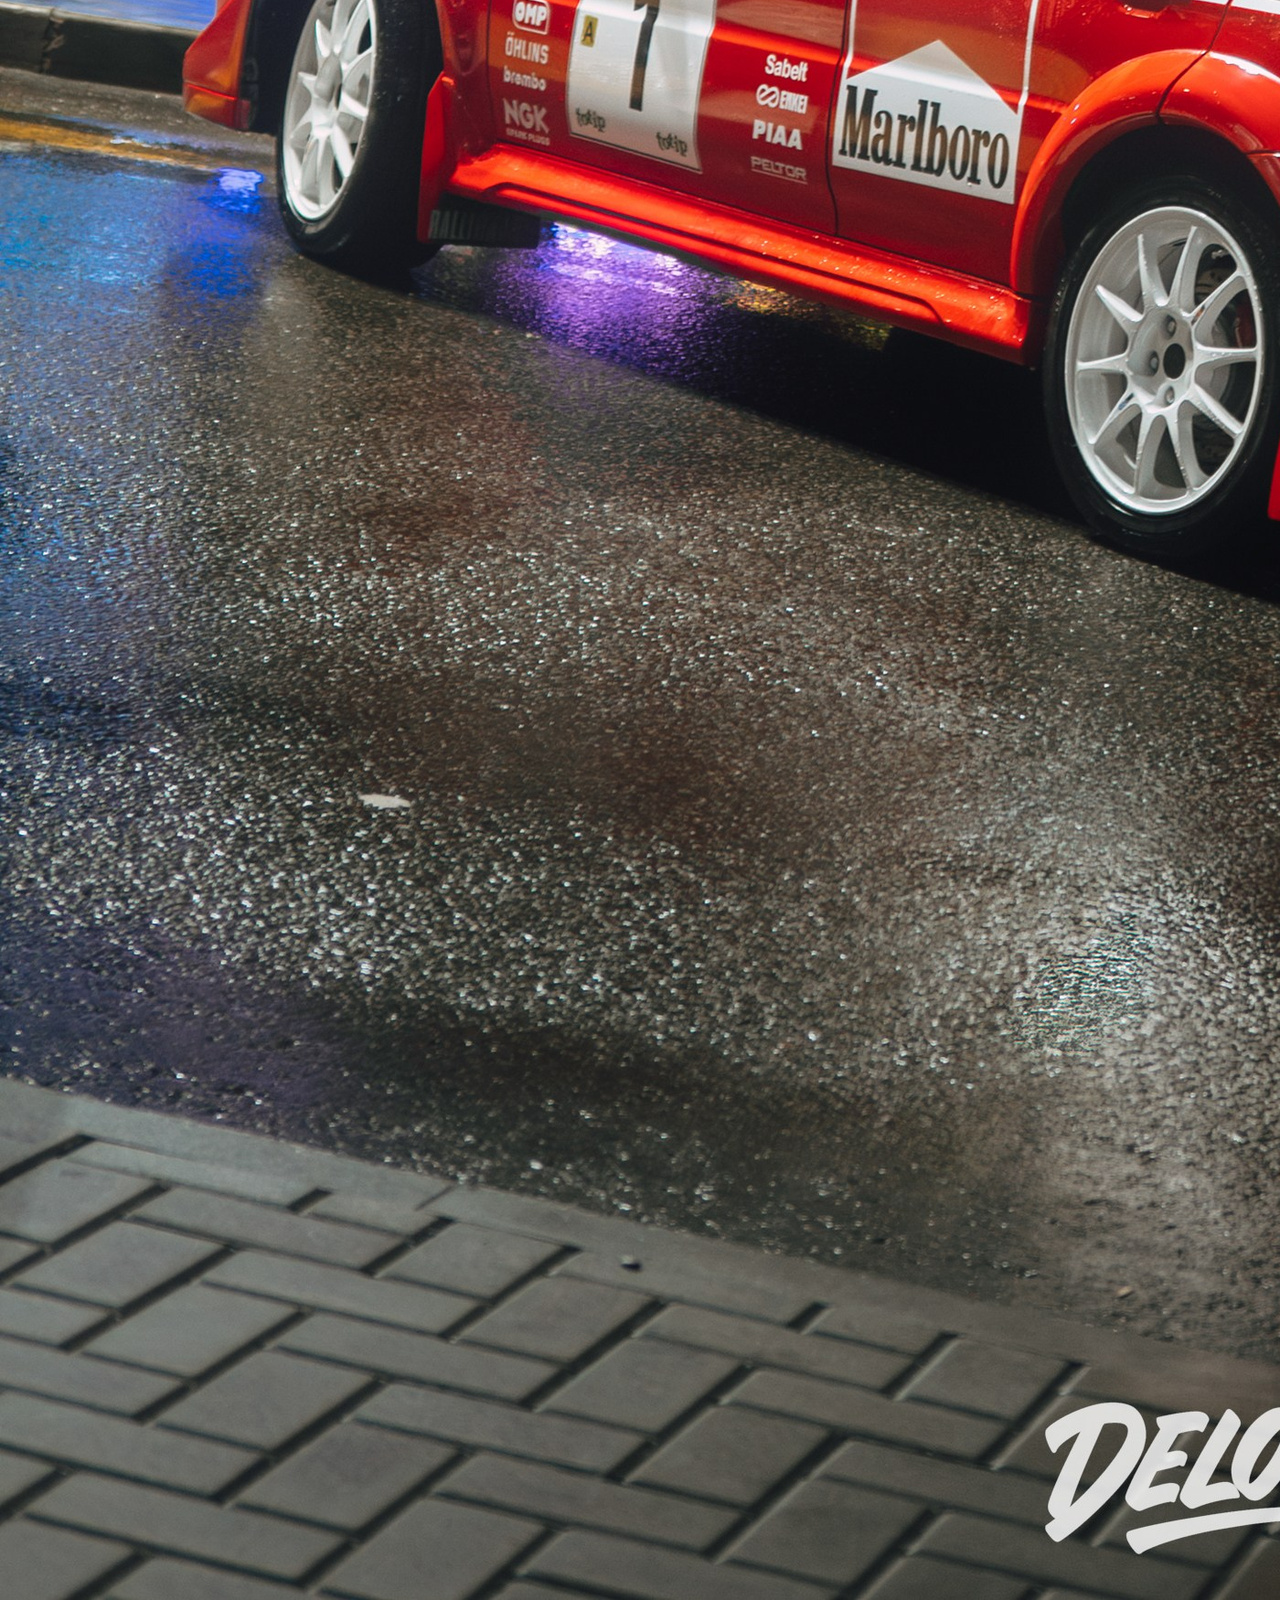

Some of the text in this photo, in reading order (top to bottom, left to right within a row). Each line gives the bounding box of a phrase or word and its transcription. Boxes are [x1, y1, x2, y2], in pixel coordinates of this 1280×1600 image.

[515, 1, 548, 27] OMP
[582, 20, 594, 43] A
[505, 30, 549, 65] ÖHLINS
[503, 65, 547, 91] brembo
[765, 53, 808, 83] Sabelt
[503, 98, 550, 134] NGK
[779, 90, 809, 115] ENKEI
[752, 119, 803, 150] PIAA
[839, 84, 1009, 189] Marlboro
[750, 156, 807, 181] PELTOR
